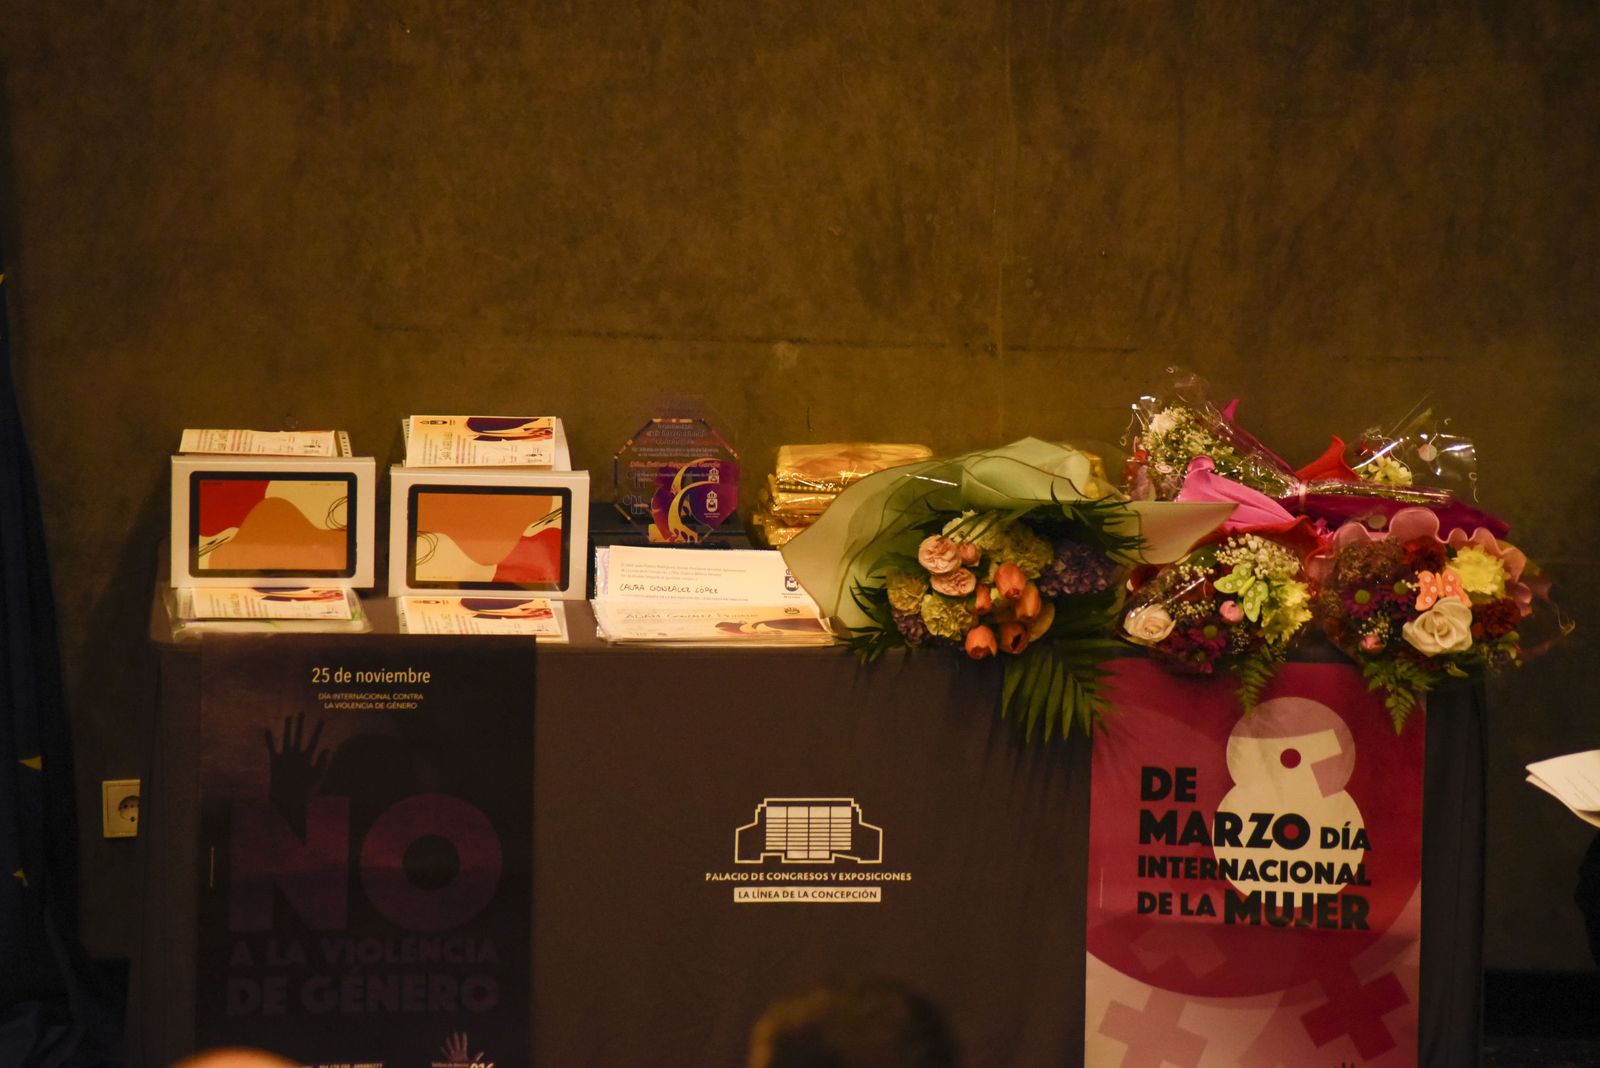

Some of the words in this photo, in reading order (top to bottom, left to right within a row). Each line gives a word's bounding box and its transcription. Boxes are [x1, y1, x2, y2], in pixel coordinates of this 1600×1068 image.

[311, 667, 331, 684] 25
[333, 666, 352, 684] de
[355, 666, 432, 684] noviembre
[323, 702, 334, 710] LA
[335, 702, 374, 710] VIOLENCIA
[374, 702, 385, 710] DE
[386, 700, 418, 710] GÉNERO
[333, 692, 391, 701] INTERNACIONAL
[392, 692, 424, 701] CONTRA
[1140, 766, 1198, 802] DE
[1137, 809, 1311, 851] MARZO
[1319, 820, 1373, 852] DÍA
[227, 792, 504, 933] NO
[705, 872, 749, 882] PALACIO
[751, 872, 765, 882] DE
[766, 872, 829, 882] CONGRESOS
[830, 872, 837, 882] Y
[838, 872, 913, 882] EXPOSICIONES
[1136, 854, 1373, 887] INTERNACIONAL
[738, 889, 750, 899] LA
[751, 887, 780, 899] LÍNEA
[782, 889, 796, 899] DE
[797, 889, 810, 899] LA
[811, 888, 878, 899] CONCEPCIÓN
[1136, 891, 1173, 915] DE
[1180, 892, 1217, 918] LA
[1223, 889, 1371, 931] MUJER
[267, 938, 308, 966] LA
[319, 938, 498, 965] VIOLENCIA
[226, 975, 289, 1016] DE
[301, 964, 500, 1015] GÉNERO
